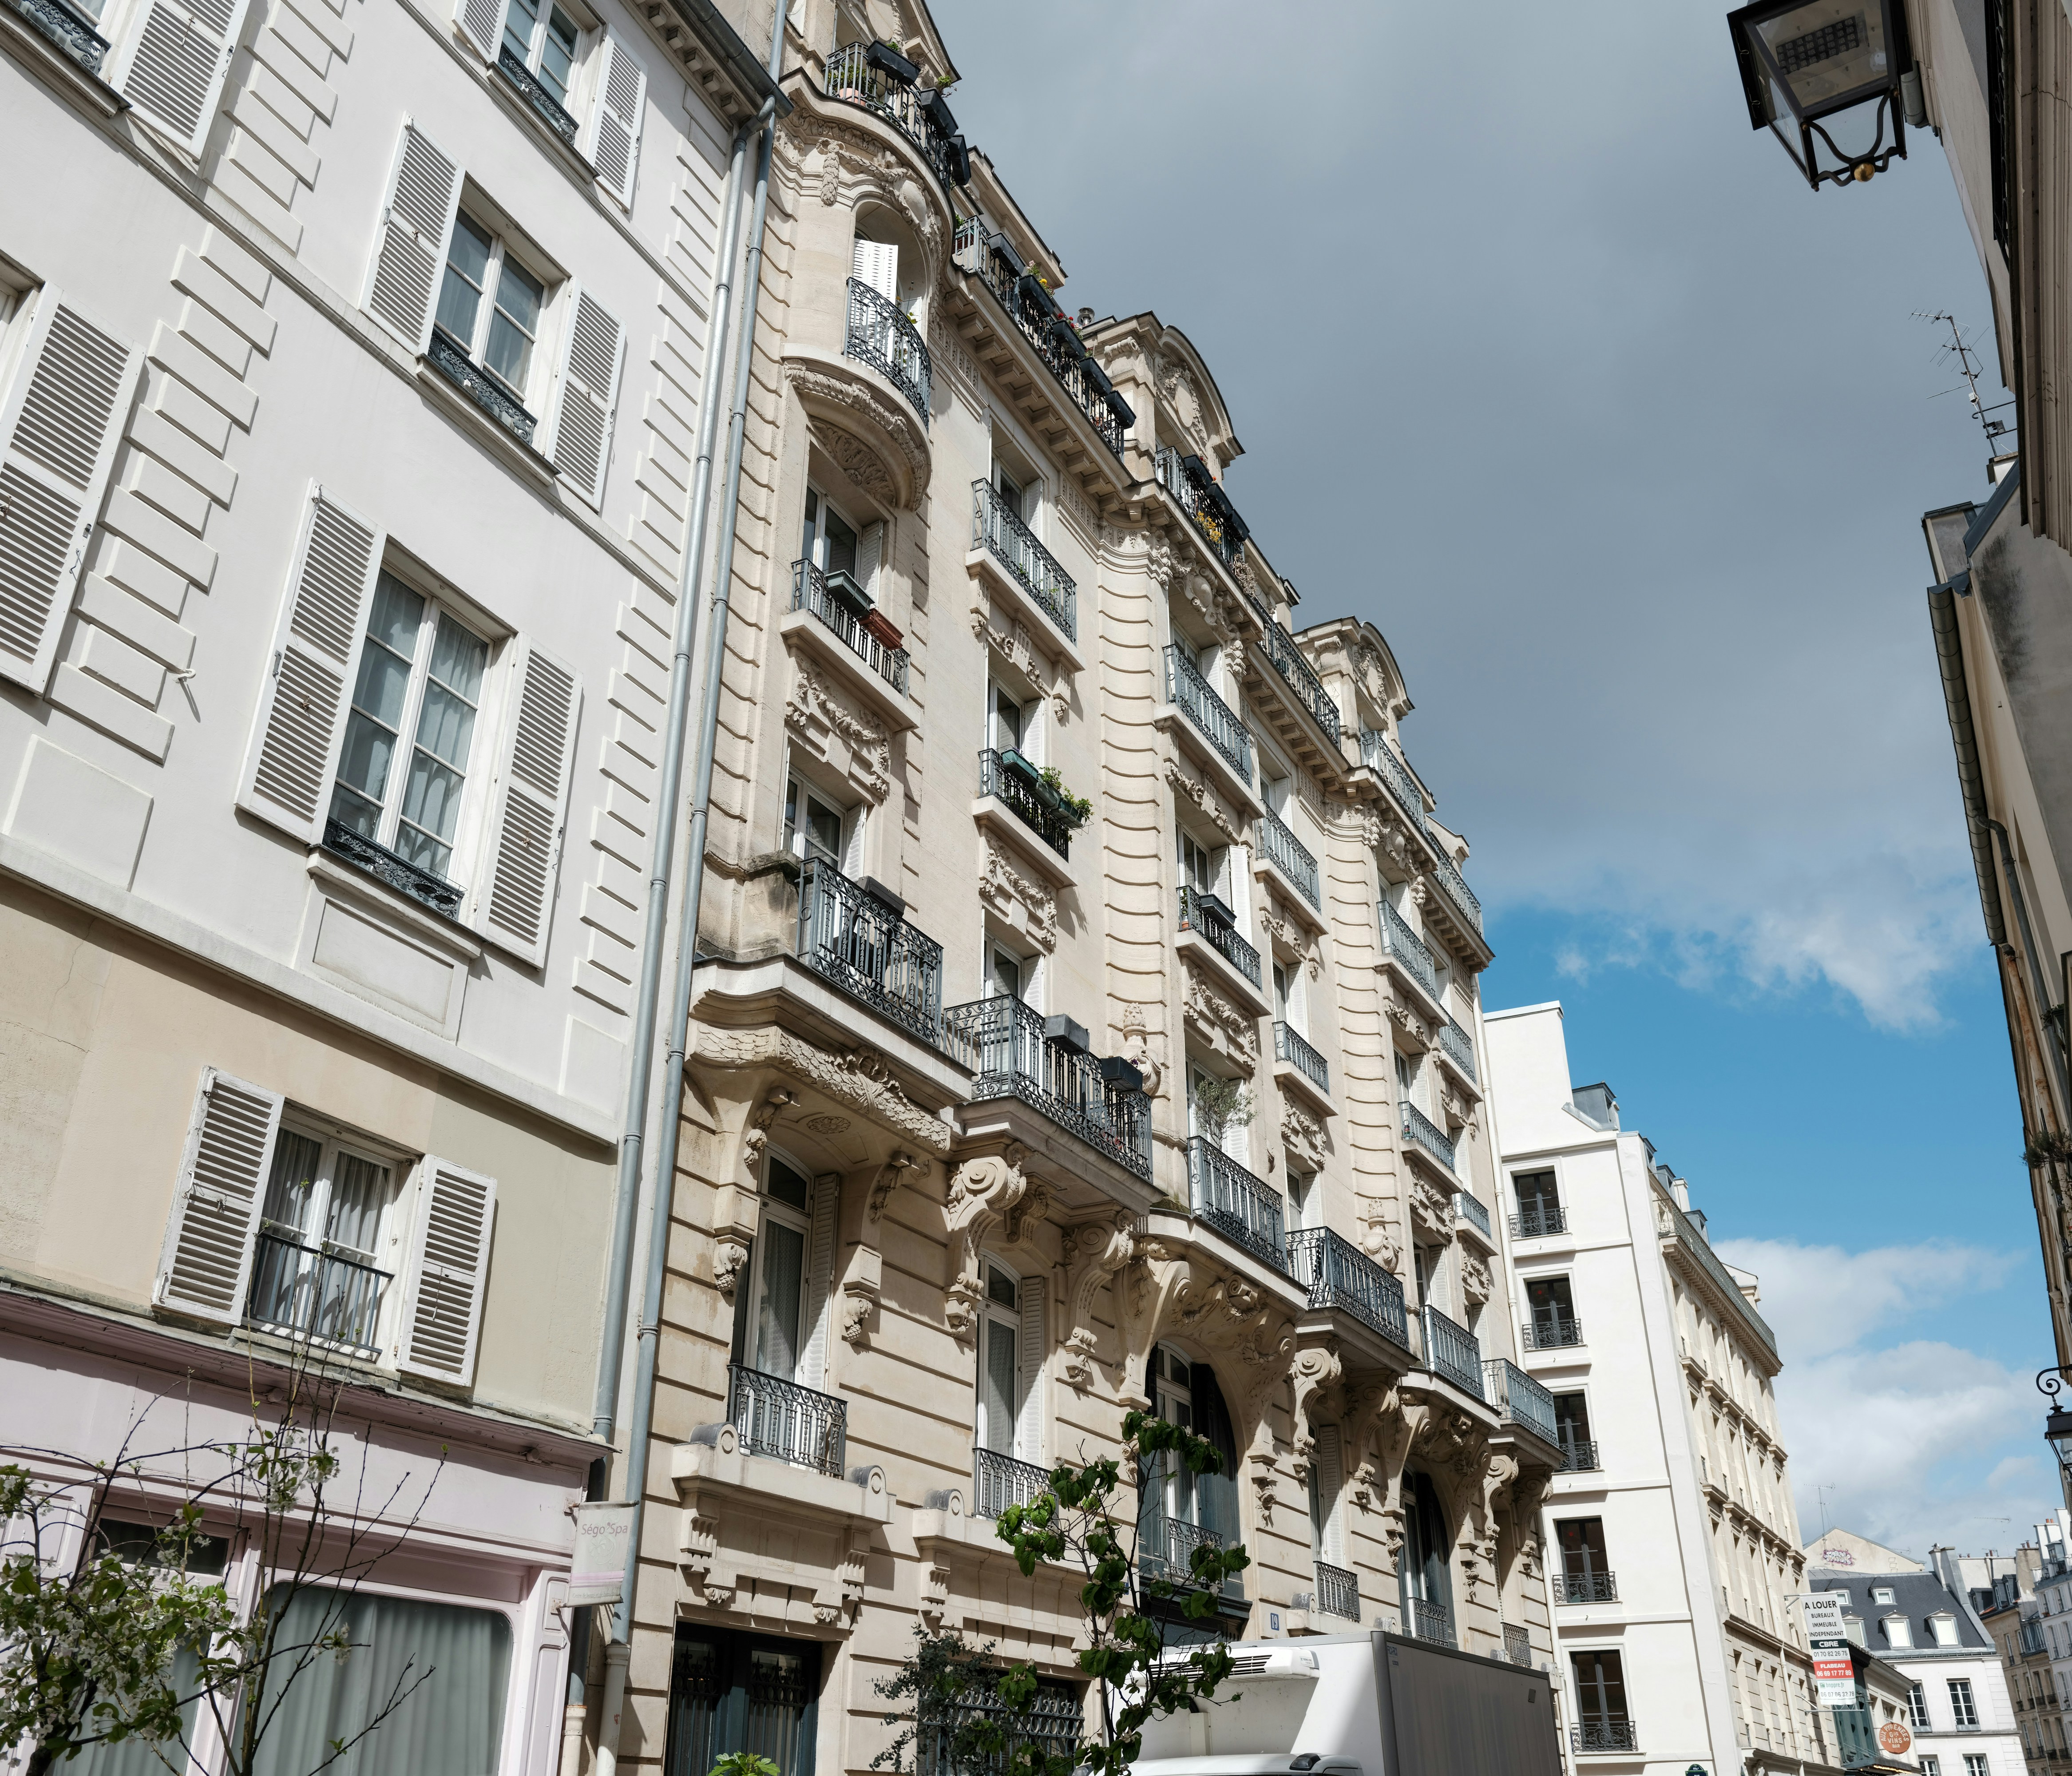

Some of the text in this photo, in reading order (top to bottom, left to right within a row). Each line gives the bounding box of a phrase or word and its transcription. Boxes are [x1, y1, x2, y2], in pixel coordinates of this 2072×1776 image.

[581, 1522, 628, 1537] Ségo'Spa
[1812, 1600, 1837, 1609] LOUER
[1272, 1614, 1278, 1629] 19
